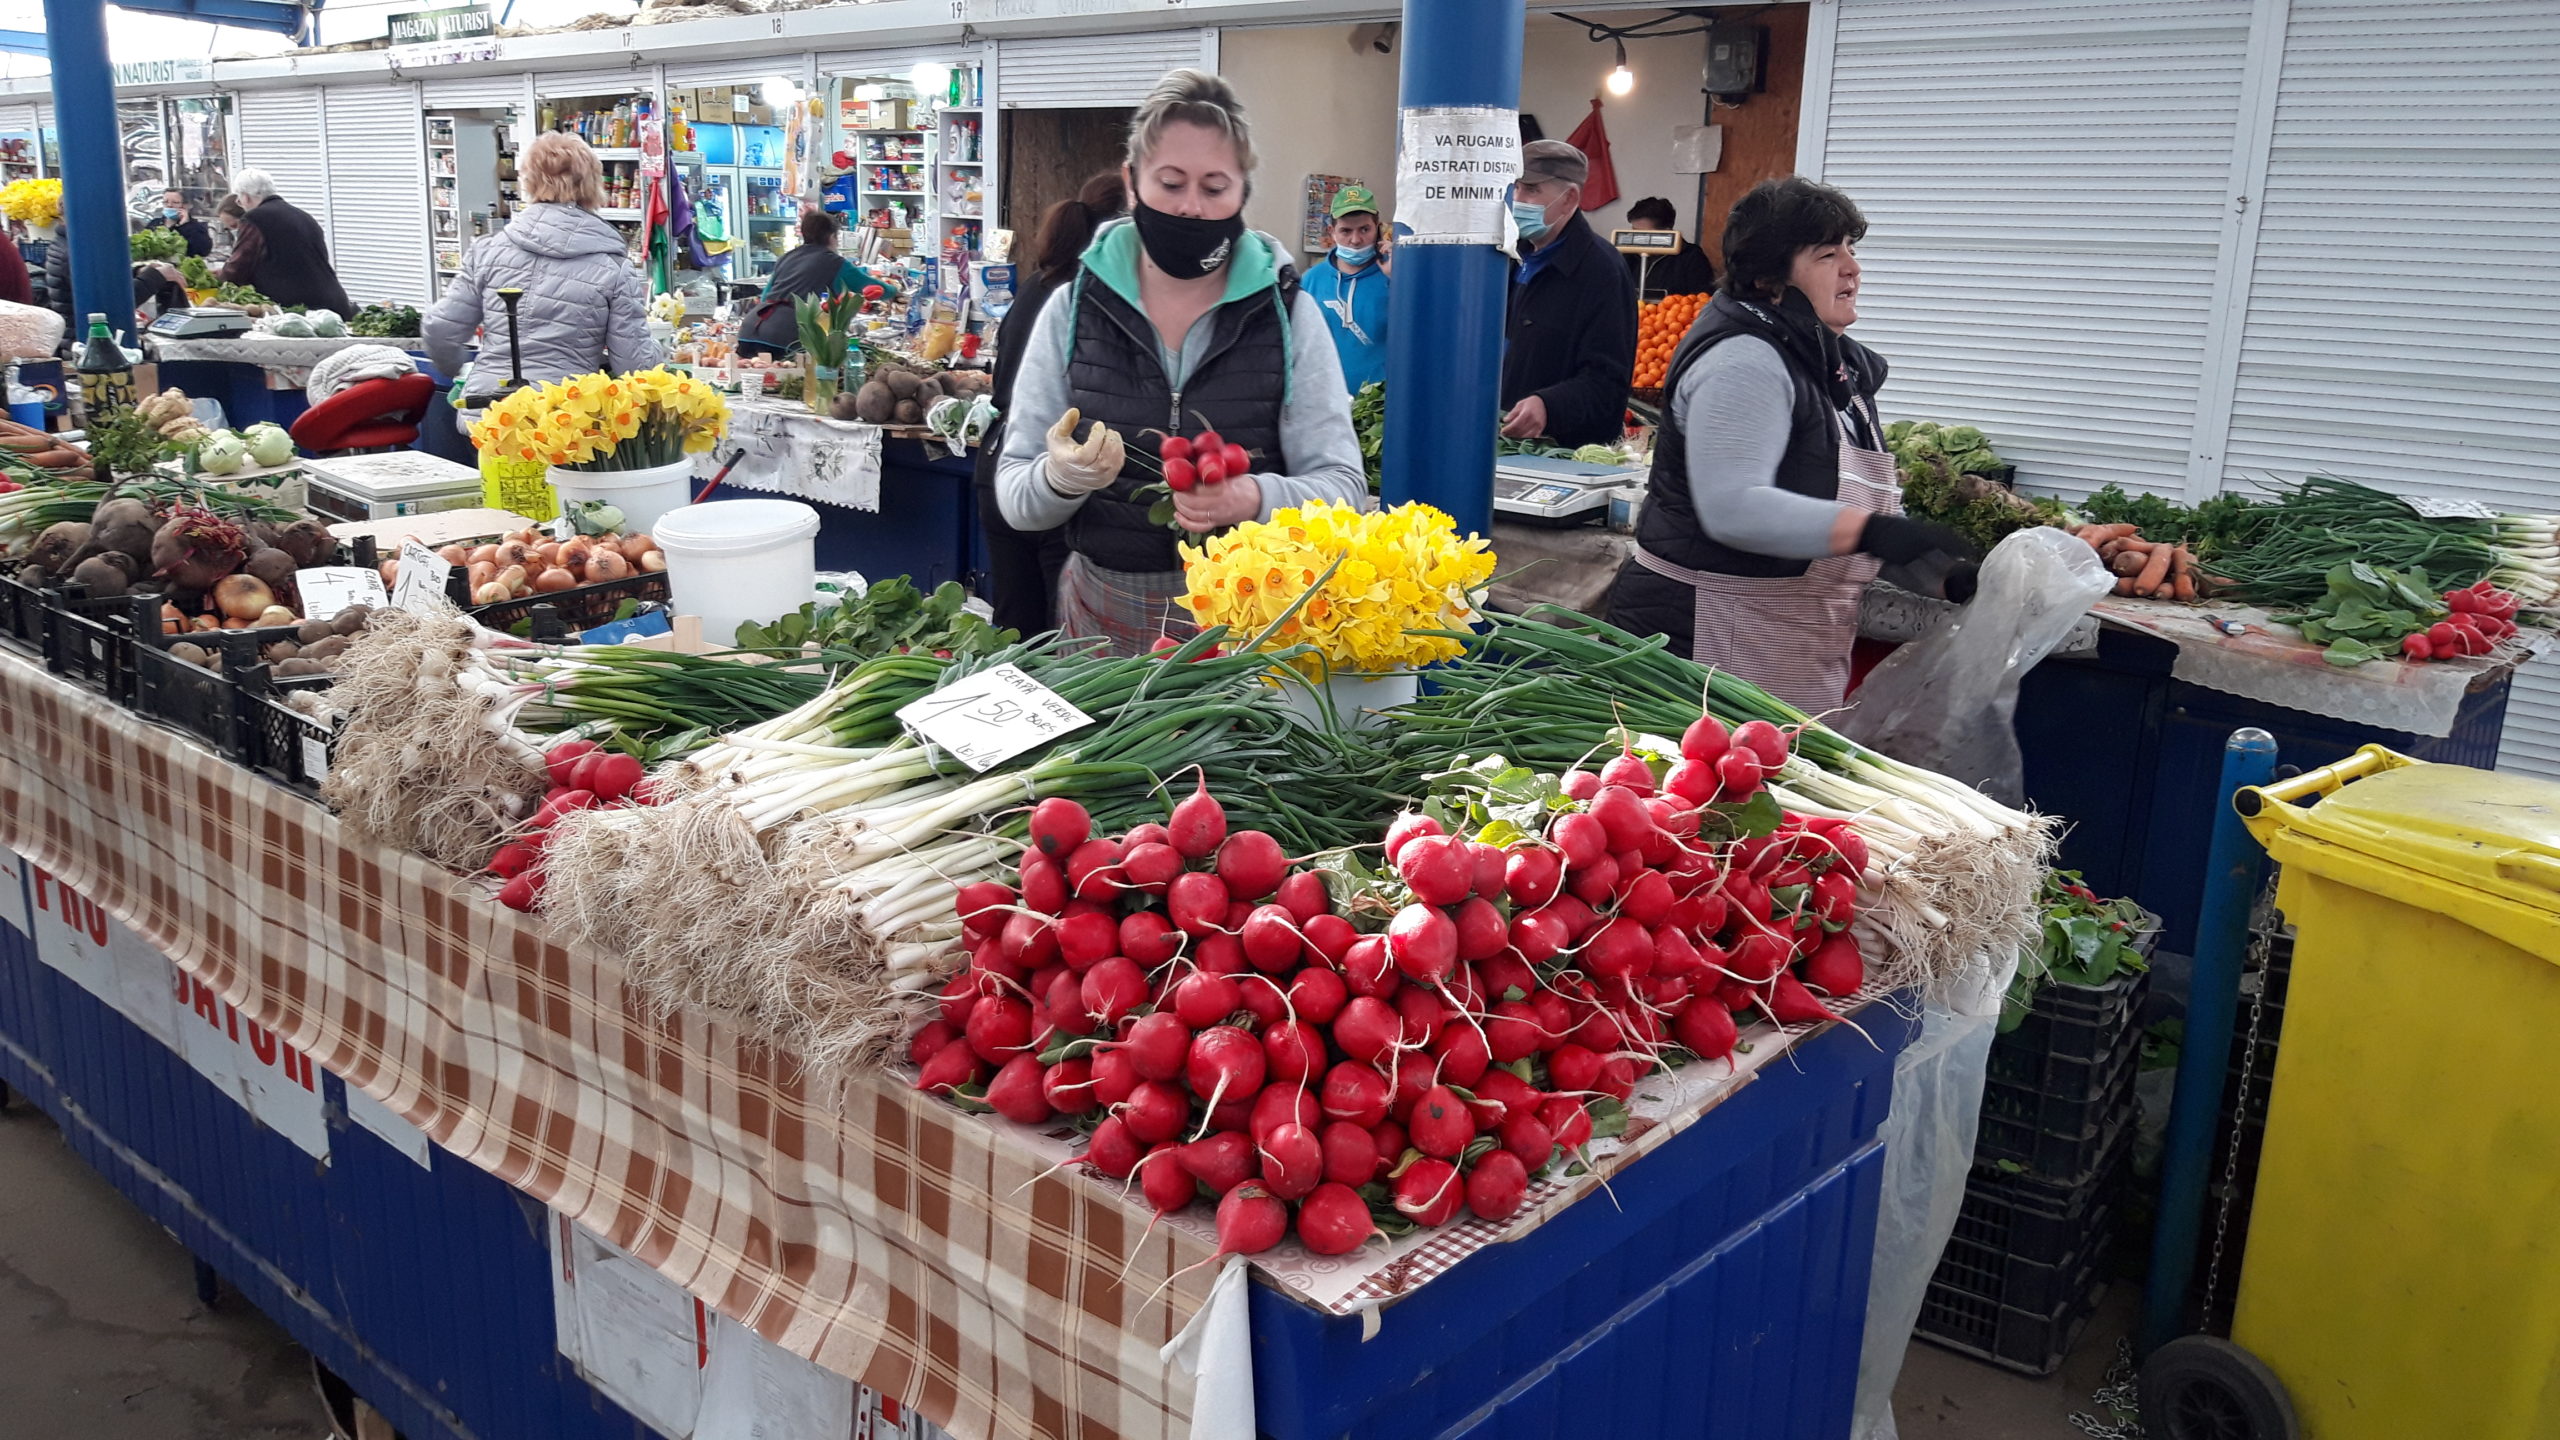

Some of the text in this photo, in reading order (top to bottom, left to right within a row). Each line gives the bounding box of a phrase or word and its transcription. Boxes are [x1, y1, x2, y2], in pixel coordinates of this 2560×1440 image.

[951, 2, 963, 20] 19
[391, 17, 436, 39] MAGAZIN
[771, 18, 782, 34] 18
[622, 32, 631, 48] 17
[122, 60, 175, 84] NATURIST
[1434, 134, 1516, 150] VA RUGAM SA
[1414, 160, 1480, 173] PASTRATI
[1425, 186, 1446, 199] DE
[1451, 186, 1495, 200] MINIM
[308, 572, 356, 586] 4
[977, 699, 1025, 723] 50
[1041, 698, 1080, 724] VERDE
